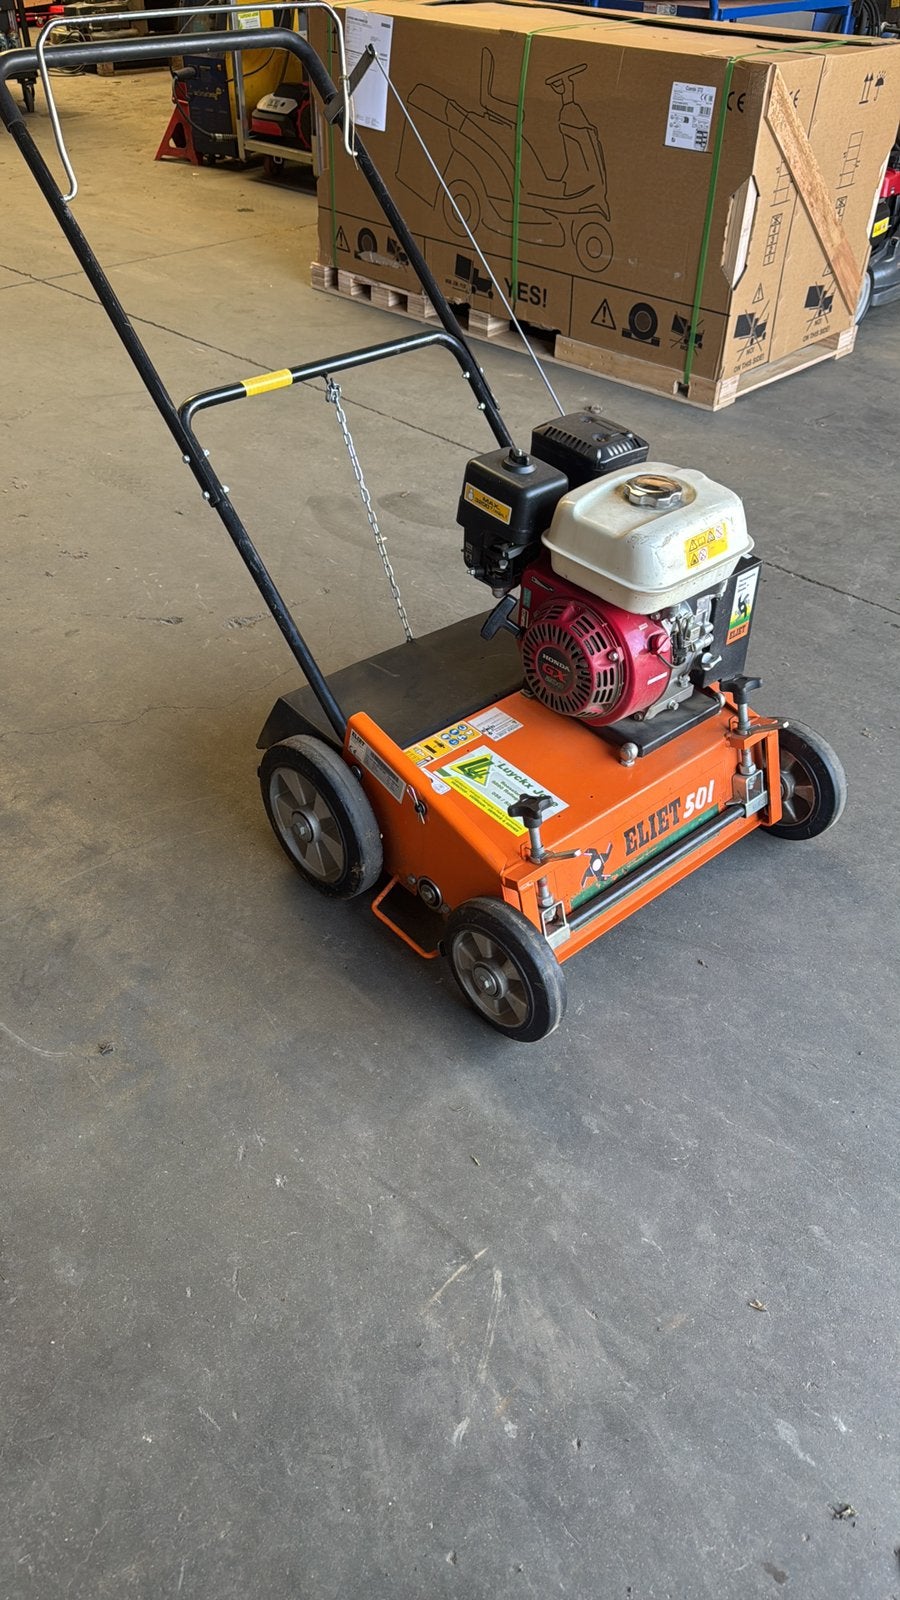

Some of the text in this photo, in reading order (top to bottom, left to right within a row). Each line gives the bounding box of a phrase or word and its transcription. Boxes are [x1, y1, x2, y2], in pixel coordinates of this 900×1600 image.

[541, 662, 567, 683] GX
[542, 653, 571, 672] HONDA
[497, 762, 533, 790] Luyckx
[623, 797, 681, 856] ELIET
